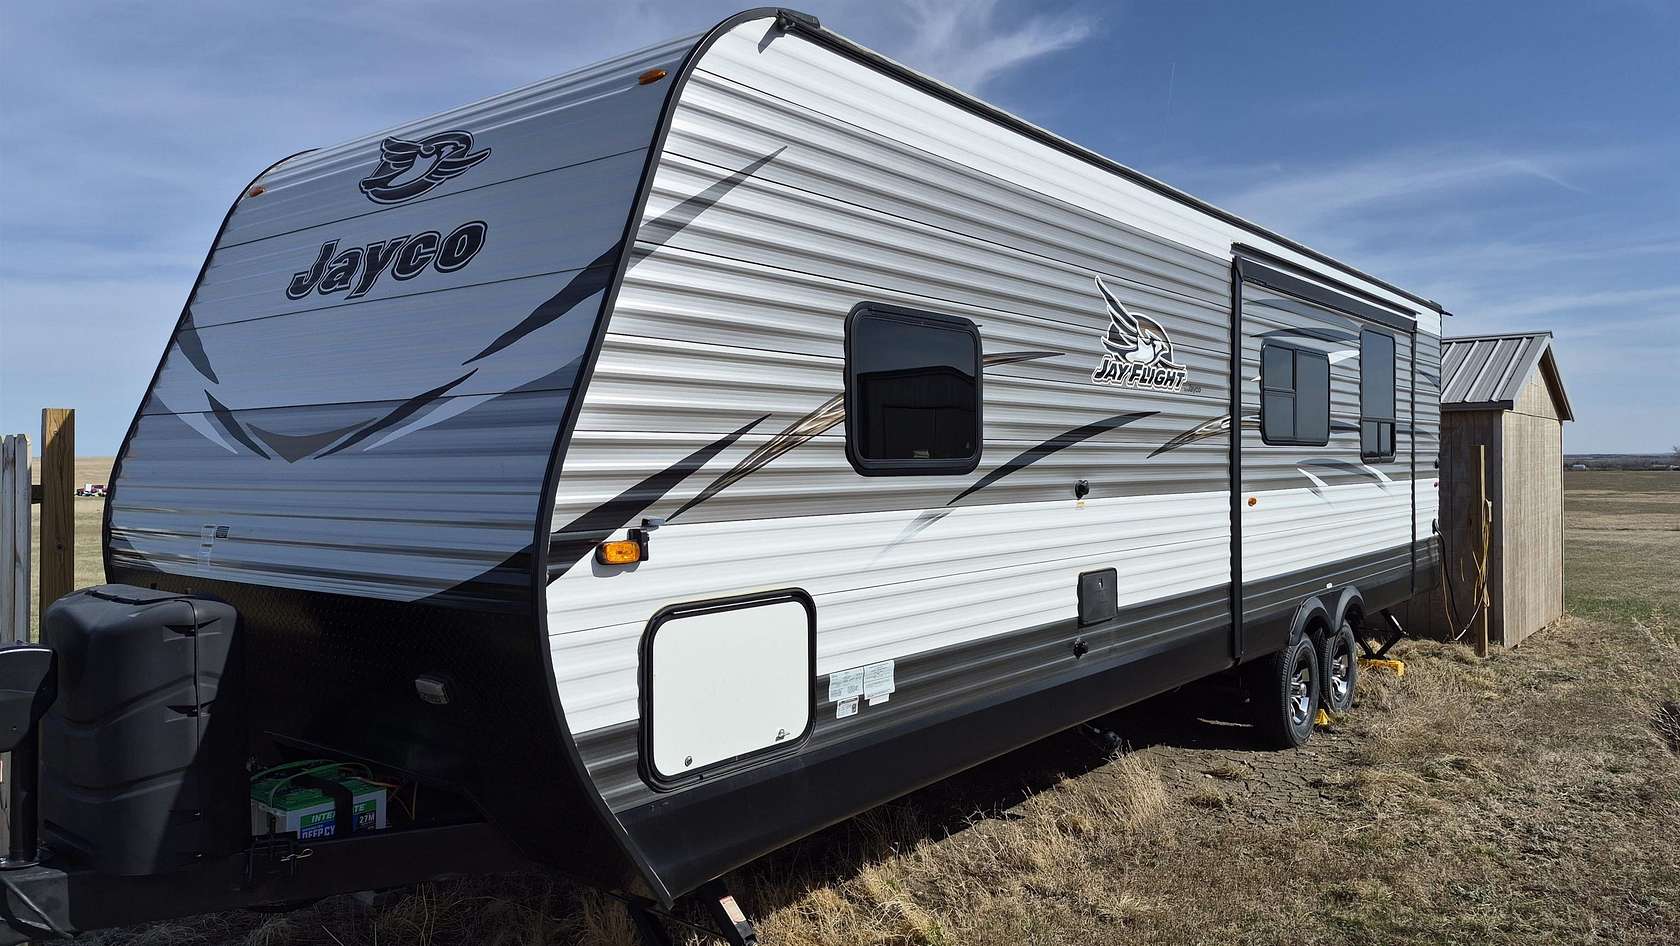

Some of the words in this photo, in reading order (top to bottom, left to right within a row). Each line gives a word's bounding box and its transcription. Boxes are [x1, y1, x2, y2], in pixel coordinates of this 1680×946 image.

[286, 221, 488, 300] Jayco
[1092, 356, 1130, 384] JAY
[1127, 362, 1187, 391] FLIGHT
